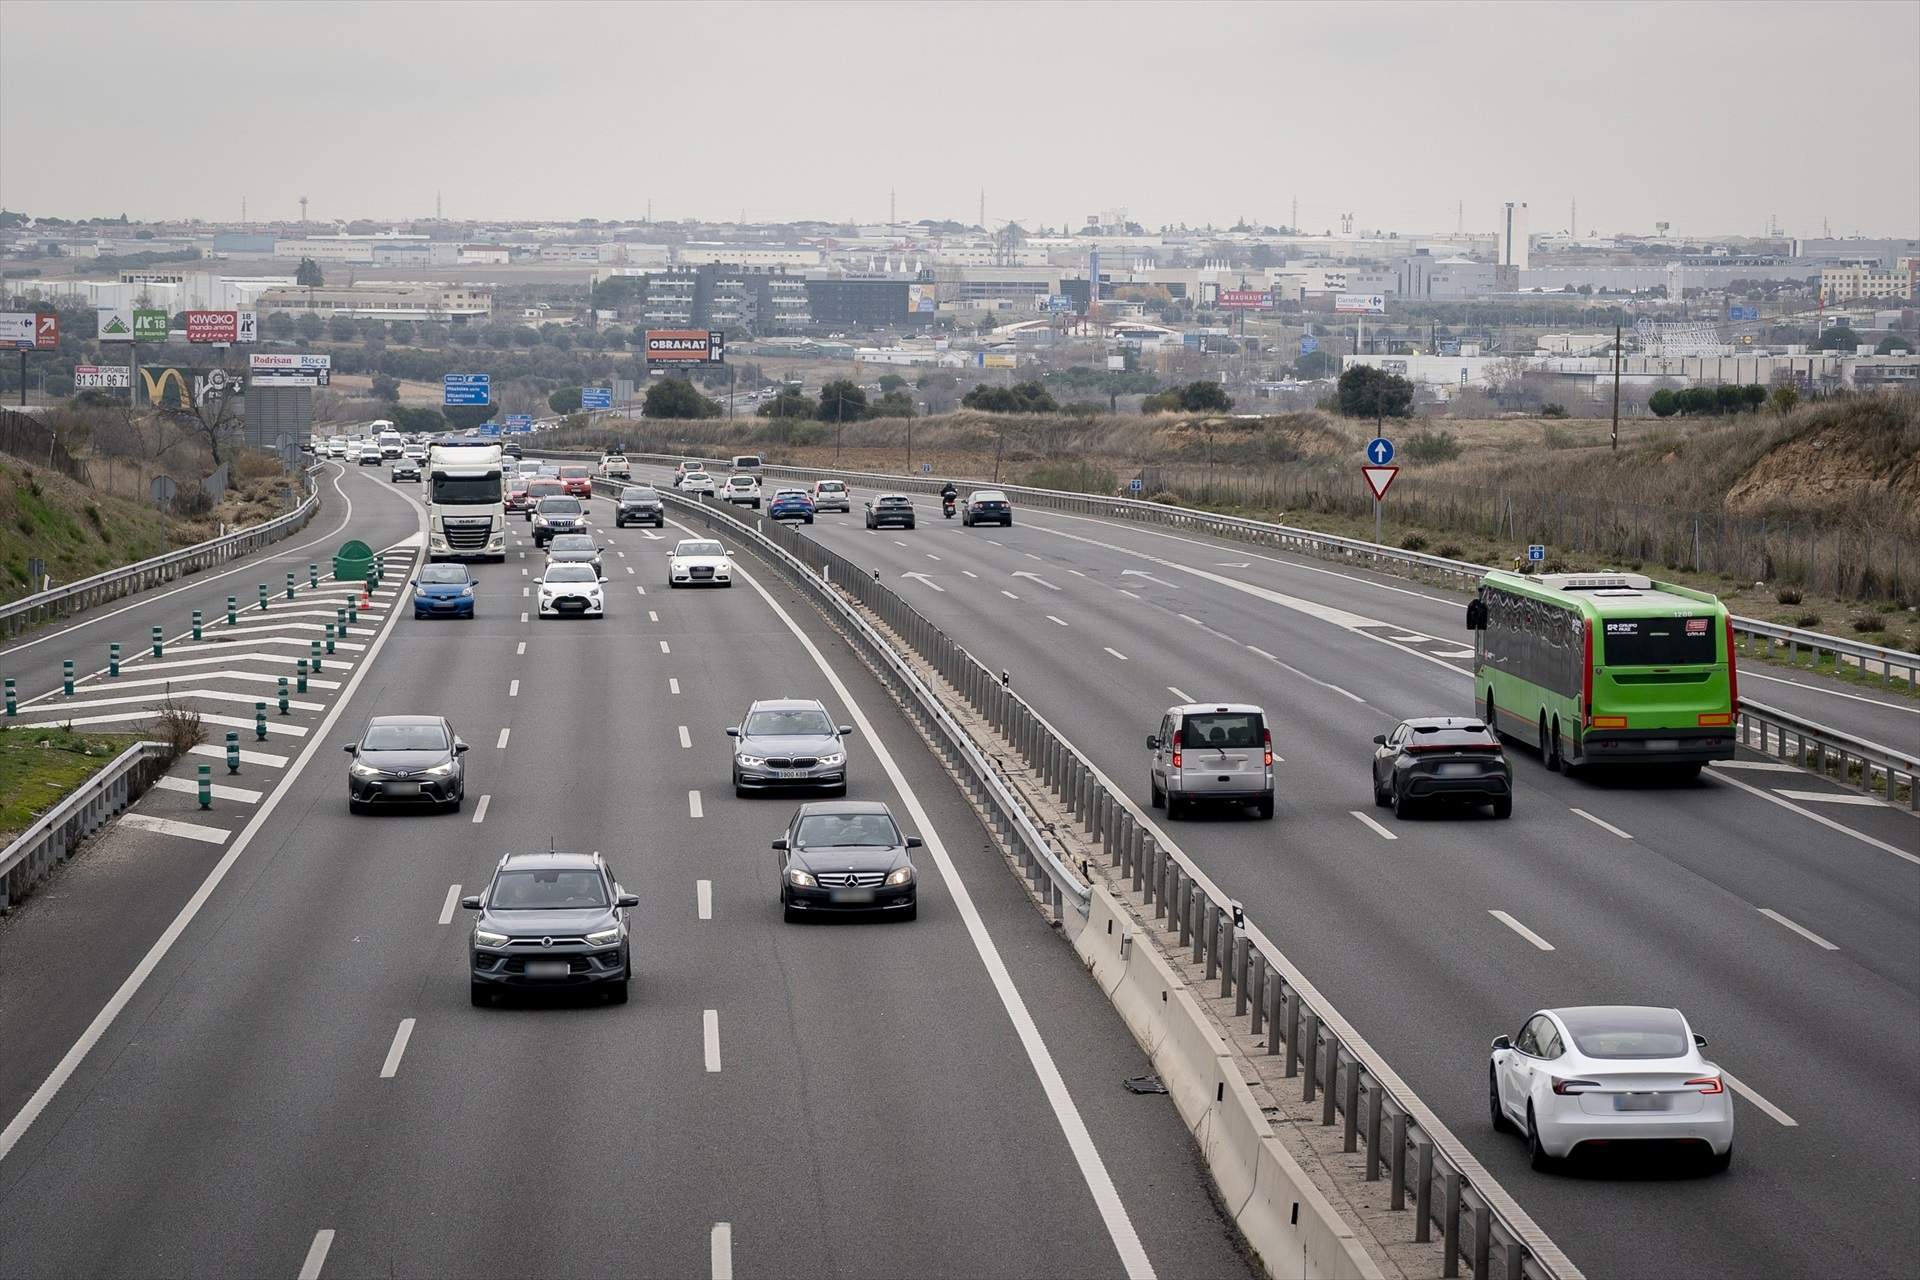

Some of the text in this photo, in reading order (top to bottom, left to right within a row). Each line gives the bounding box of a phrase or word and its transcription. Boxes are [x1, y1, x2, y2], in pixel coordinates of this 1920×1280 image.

[154, 319, 166, 329] 18
[189, 314, 234, 325] KIWOKO
[650, 340, 706, 349] OBRAMAT
[253, 355, 327, 364] Rodrisan Roca
[76, 374, 129, 386] 91 371 96 71
